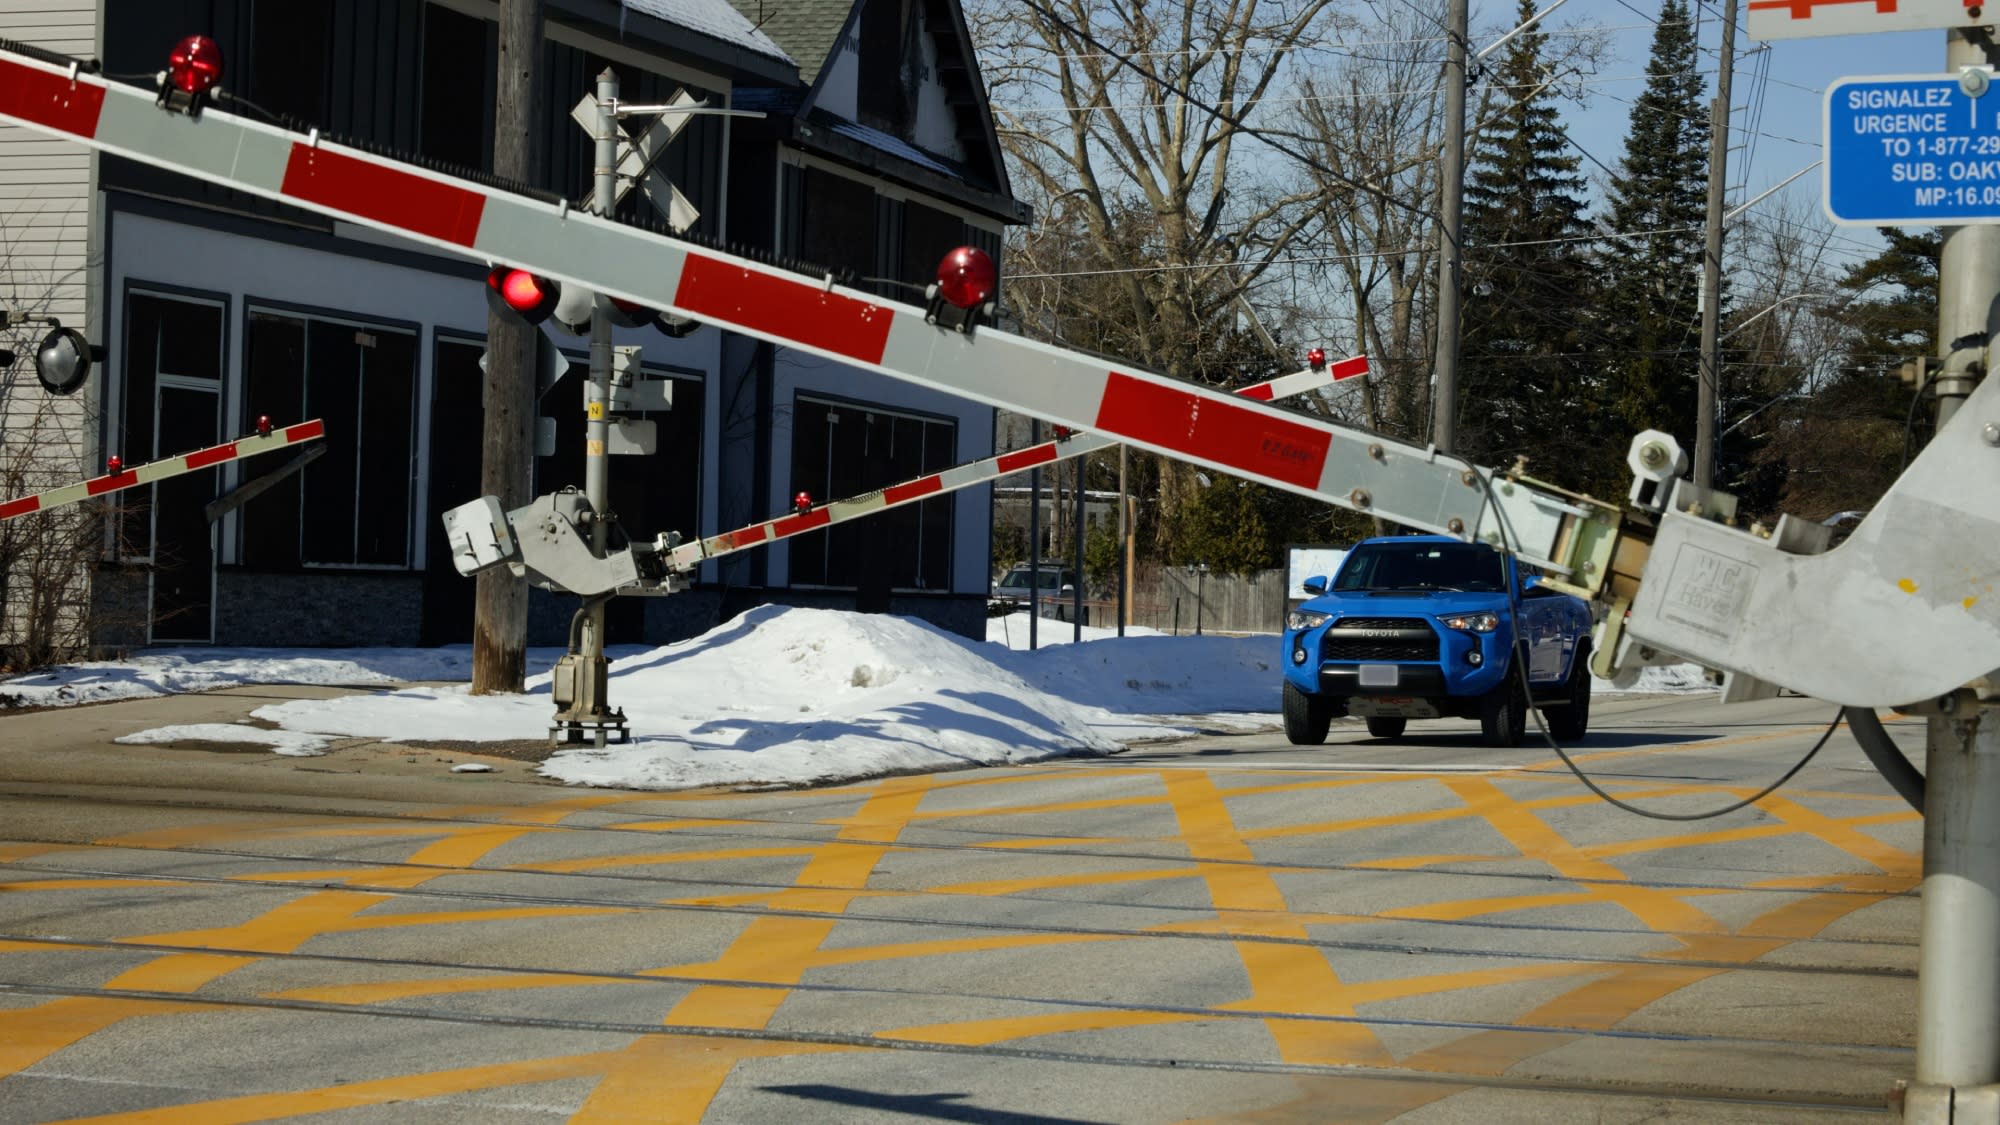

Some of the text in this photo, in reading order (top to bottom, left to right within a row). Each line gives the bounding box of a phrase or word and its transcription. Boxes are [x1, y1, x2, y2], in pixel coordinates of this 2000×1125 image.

[1848, 88, 1952, 109] SIGNALEZ
[1854, 113, 1947, 134] URGENCE
[1882, 136, 2000, 157] TO 1-877-29
[1892, 161, 2000, 181] SUB: OAK
[591, 406, 599, 416] N
